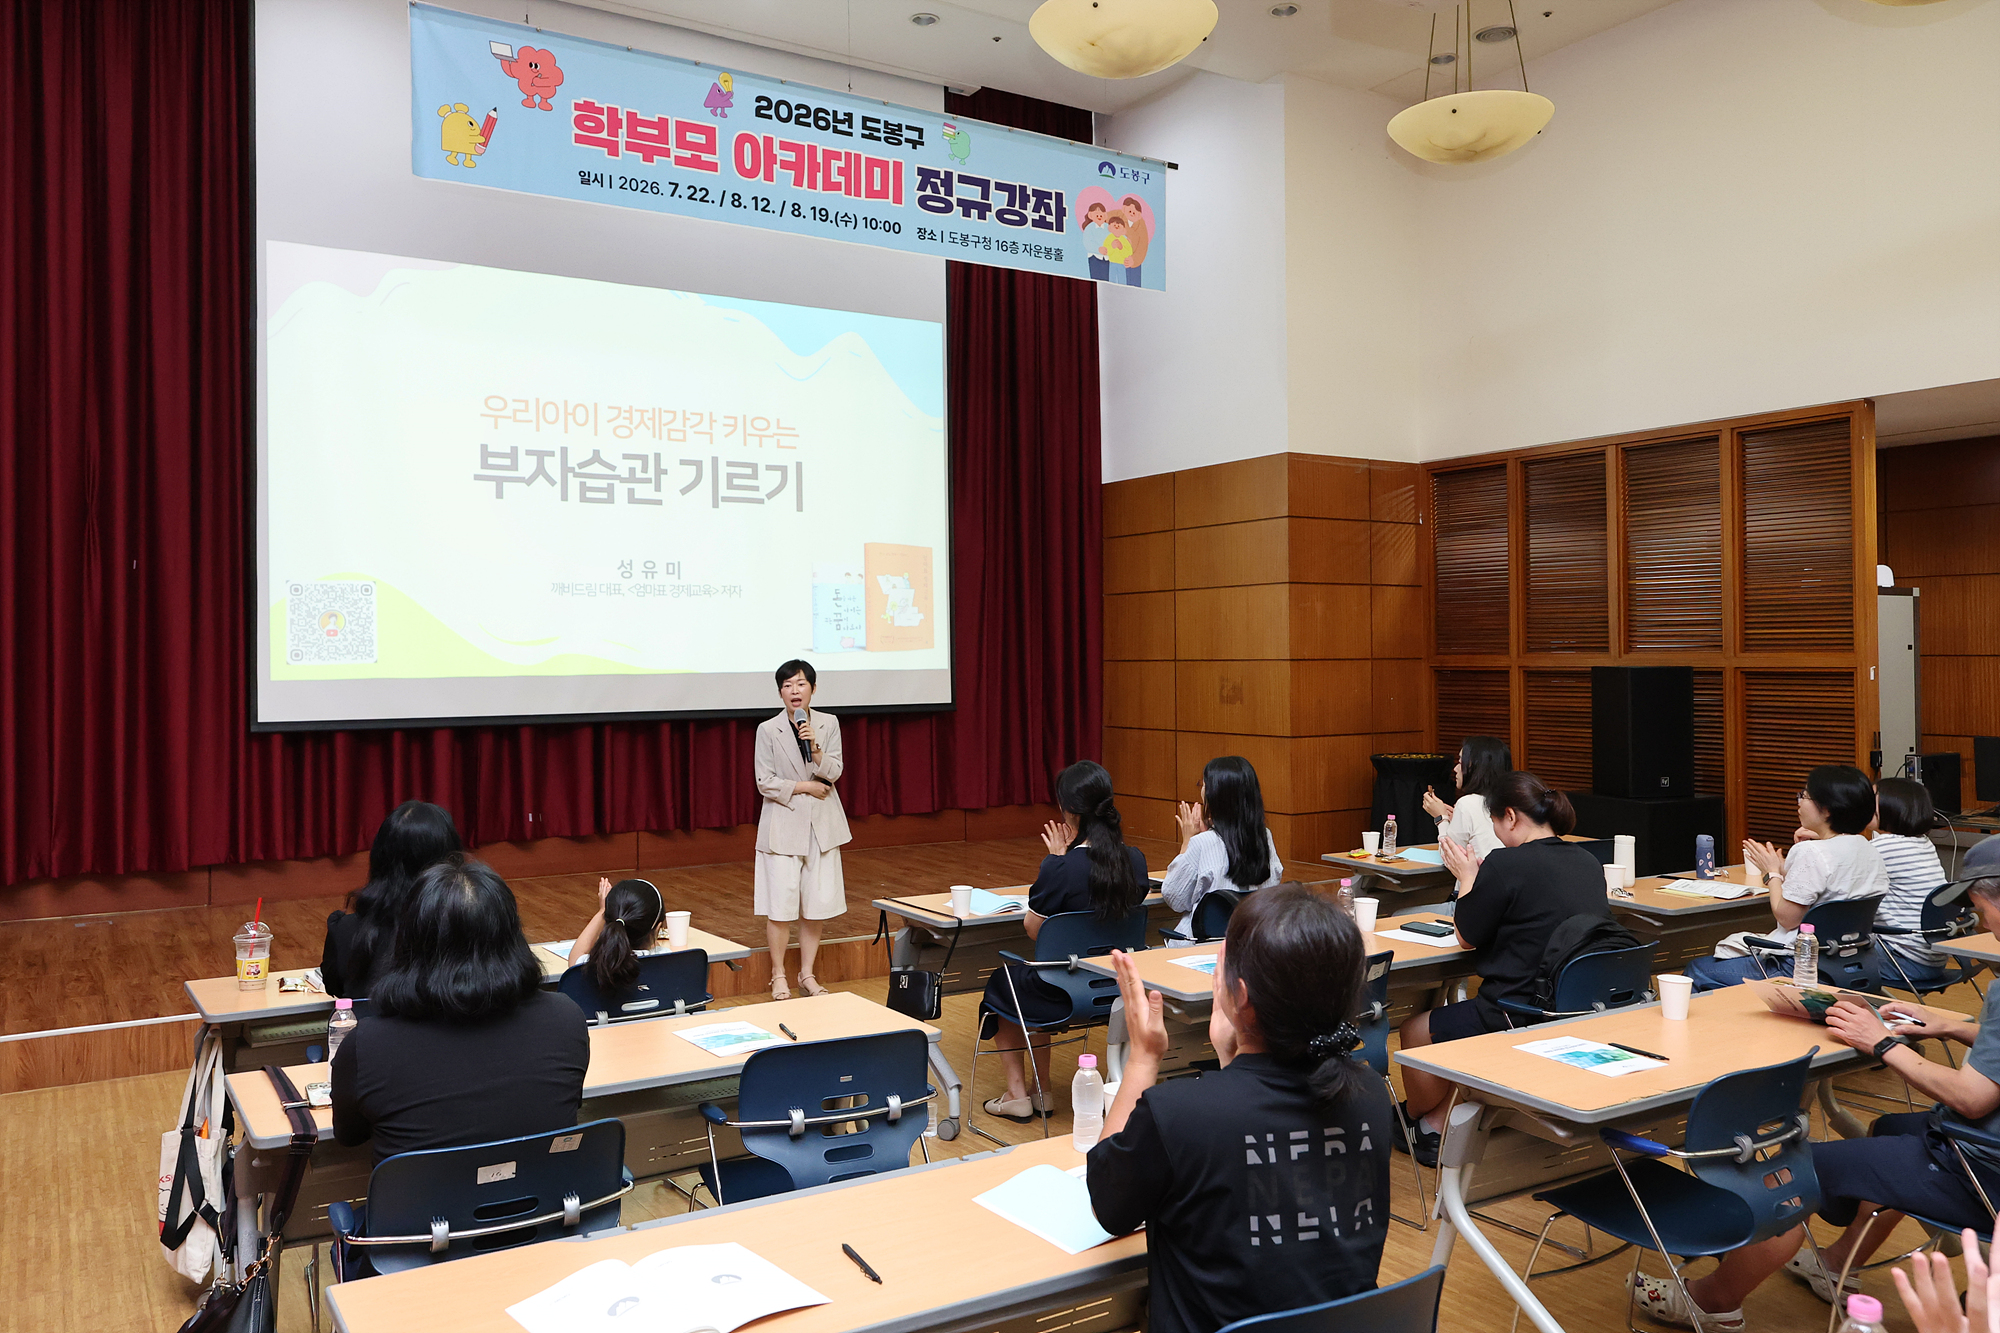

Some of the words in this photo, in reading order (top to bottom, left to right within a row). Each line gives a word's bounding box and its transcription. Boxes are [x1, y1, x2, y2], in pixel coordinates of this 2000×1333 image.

[755, 95, 853, 137] 2026년
[861, 115, 925, 150] 도봉구
[572, 98, 720, 174] 학부모
[733, 132, 904, 206] 아카데미
[915, 165, 1067, 233] 정규강좌
[1120, 167, 1150, 185] 도봉구
[578, 170, 604, 188] 일시
[618, 176, 664, 196] 2026.
[862, 216, 902, 234] 10:00
[916, 227, 937, 241] 장소
[948, 231, 992, 251] 도봉구청
[995, 239, 1020, 255] 16층
[1022, 243, 1064, 262] 자운봉홀
[480, 395, 598, 436] 우리아이
[606, 403, 718, 445] 경제감각
[723, 413, 800, 450] 키우는
[473, 443, 668, 506] 부자습관
[679, 455, 803, 513] 기르기
[551, 582, 597, 597] 깨비드림
[599, 583, 625, 597] 대표,
[627, 583, 667, 598] <엄마표
[669, 584, 720, 599] 경제교육>
[721, 585, 743, 599] 저자
